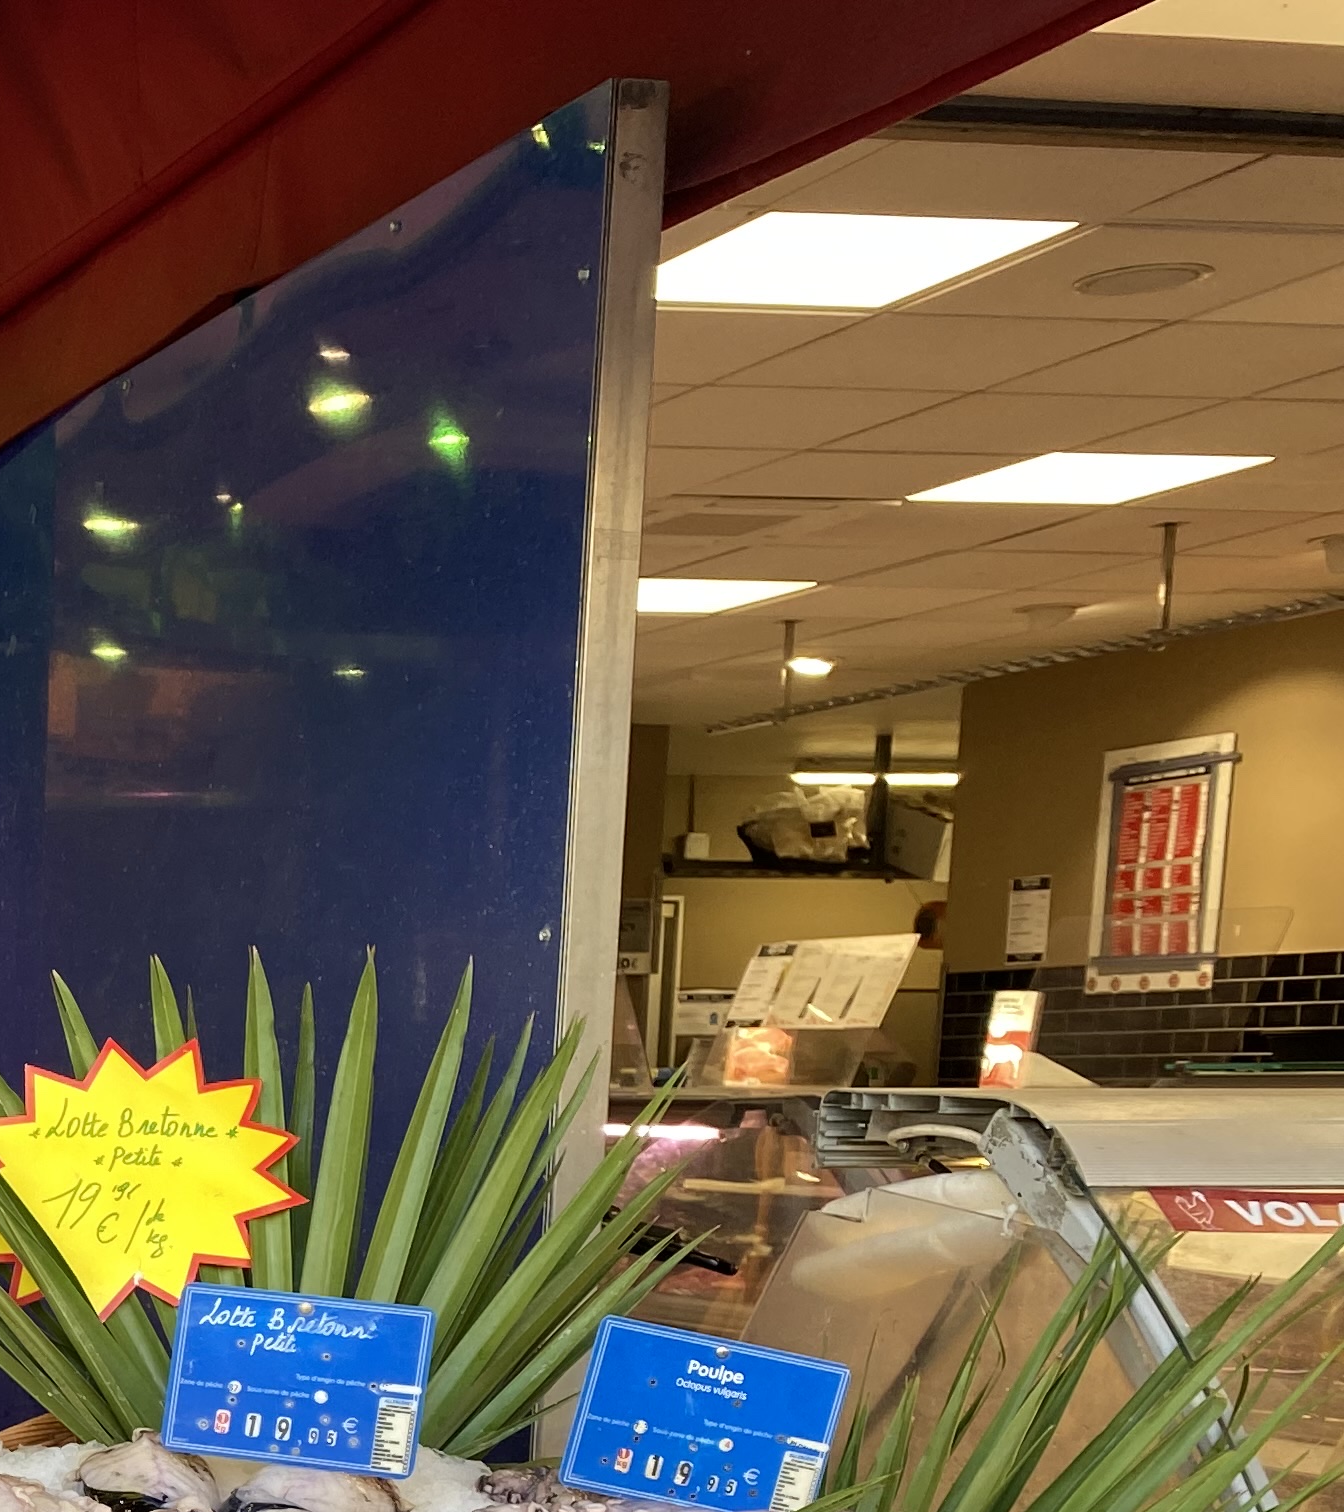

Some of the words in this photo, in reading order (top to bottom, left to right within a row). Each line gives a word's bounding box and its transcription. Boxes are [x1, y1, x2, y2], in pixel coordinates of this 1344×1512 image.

[45, 1098, 109, 1138] Lotte
[118, 1106, 218, 1138] Bretonne
[1224, 1198, 1344, 1228] VOL
[200, 1297, 256, 1328] Lotte
[688, 1359, 745, 1385] Poulpe
[675, 1377, 712, 1394] Octopus
[713, 1386, 747, 1401] vulgaris
[342, 1417, 359, 1434] €
[743, 1468, 761, 1486] €
